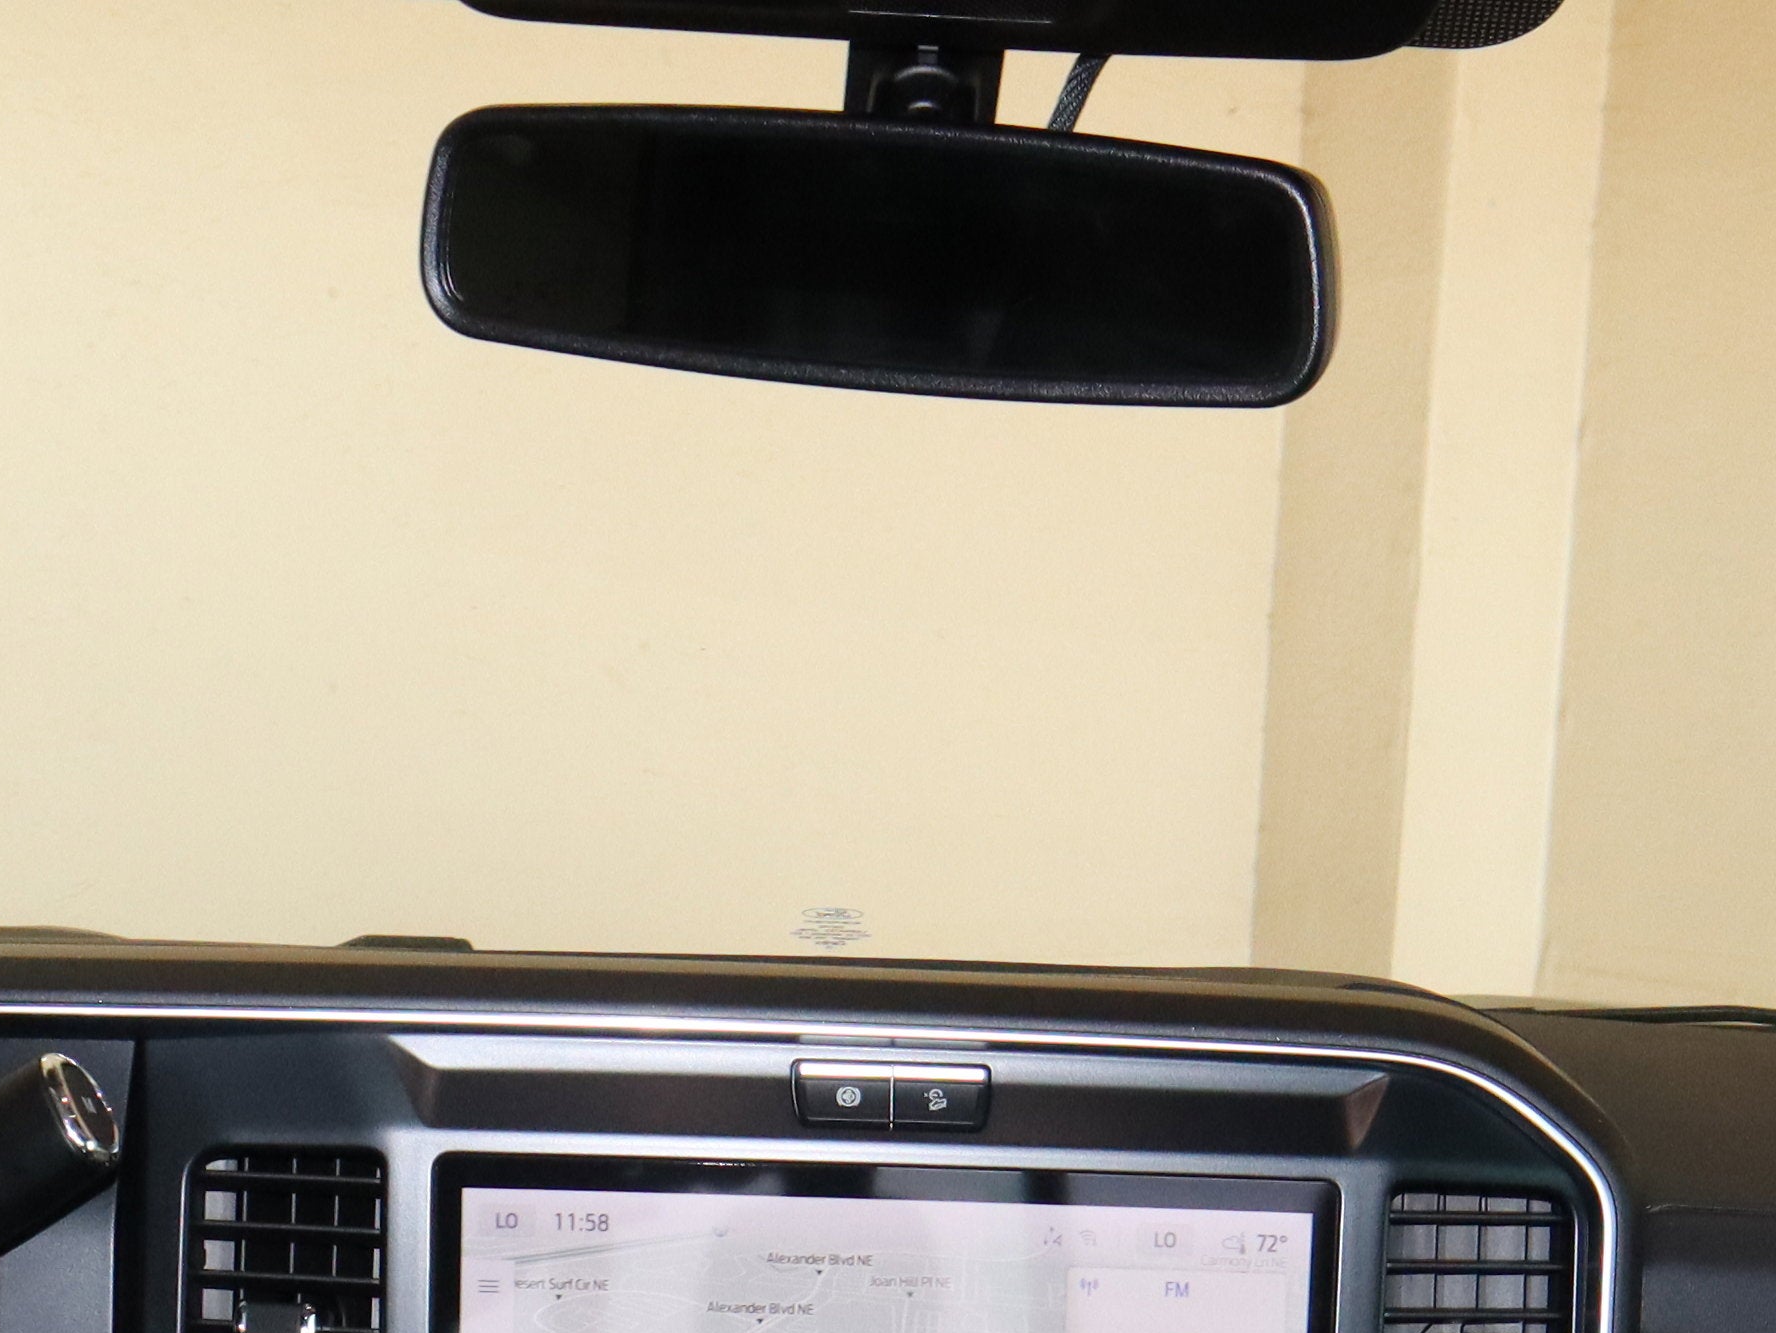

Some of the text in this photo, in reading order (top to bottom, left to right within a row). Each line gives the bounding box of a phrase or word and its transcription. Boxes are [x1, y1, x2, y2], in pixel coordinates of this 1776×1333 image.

[494, 1211, 519, 1230] LO
[553, 1212, 610, 1232] 11:58
[1153, 1232, 1177, 1249] LO
[765, 1251, 874, 1267] Alexander Blvd NE
[513, 1278, 545, 1290] esert
[593, 1279, 609, 1291] NE
[935, 1277, 951, 1288] NE
[1164, 1282, 1190, 1299] FM
[706, 1301, 816, 1316] Alexander Blvd NE
